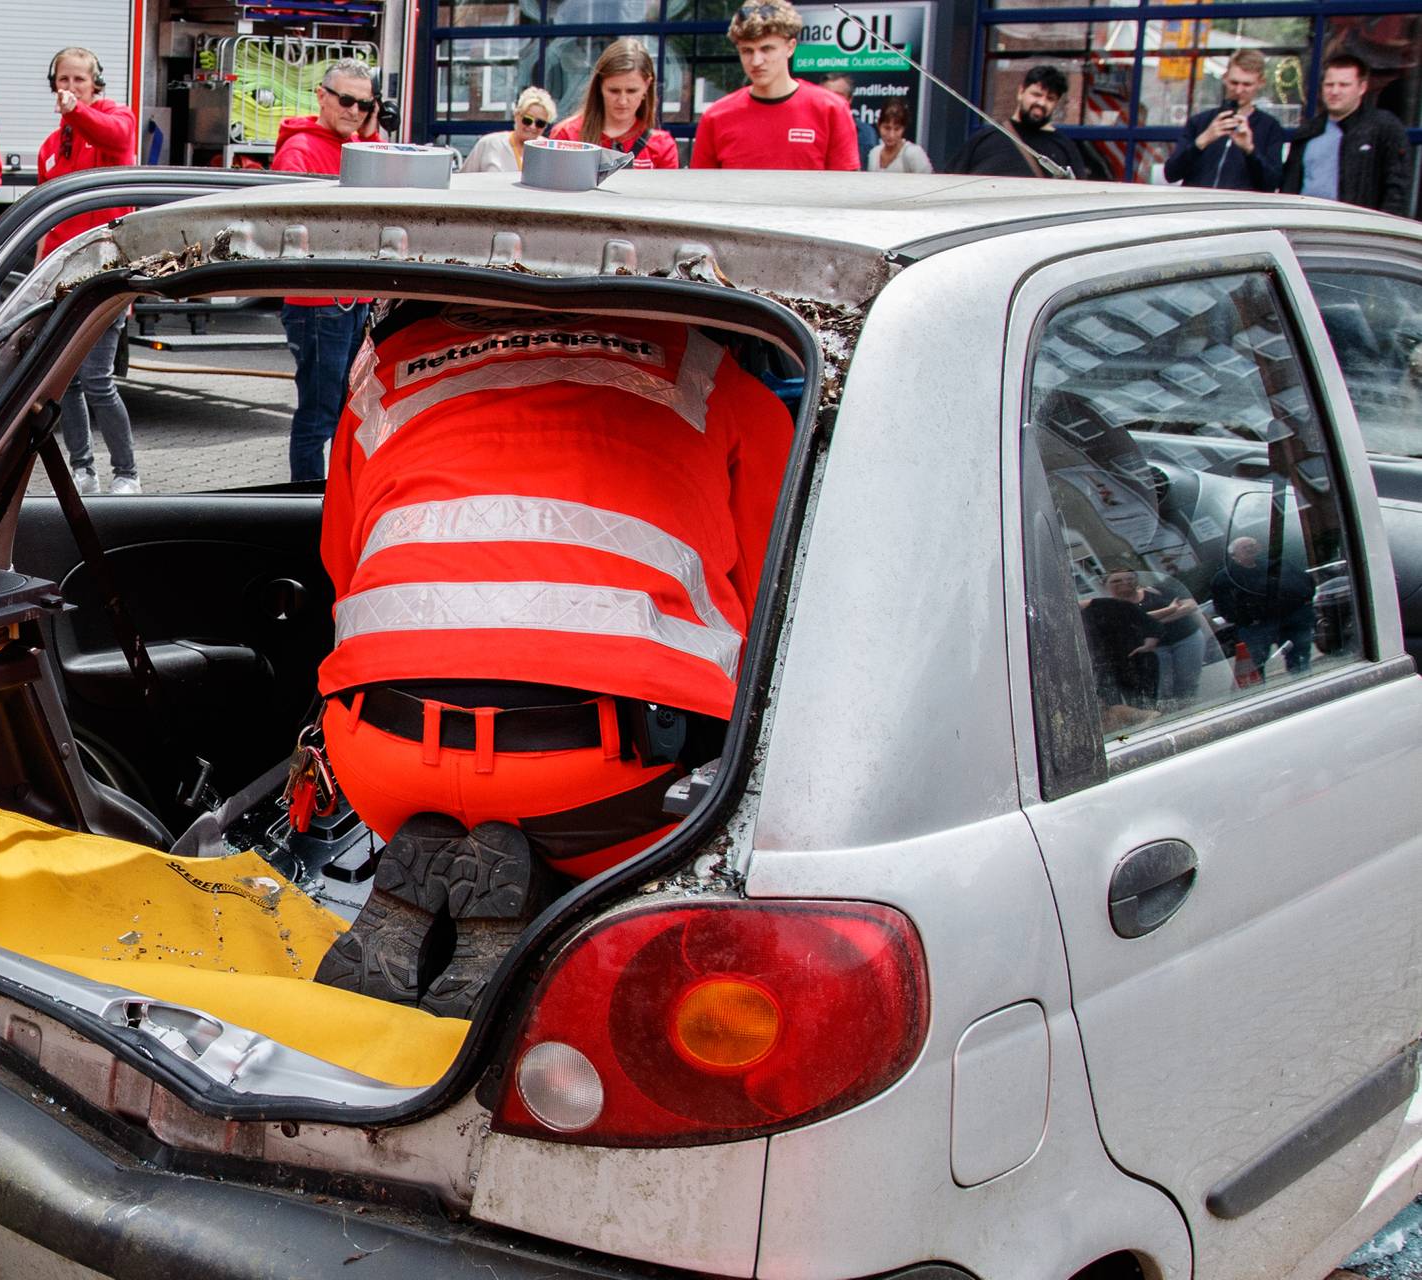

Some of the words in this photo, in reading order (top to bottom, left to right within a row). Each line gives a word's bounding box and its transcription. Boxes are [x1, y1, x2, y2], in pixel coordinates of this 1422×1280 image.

[836, 15, 906, 52] OIL
[797, 58, 815, 68] DER
[817, 57, 850, 67] GRÜNE
[406, 332, 653, 376] Rettungsdienst
[170, 861, 223, 891] WEBER
